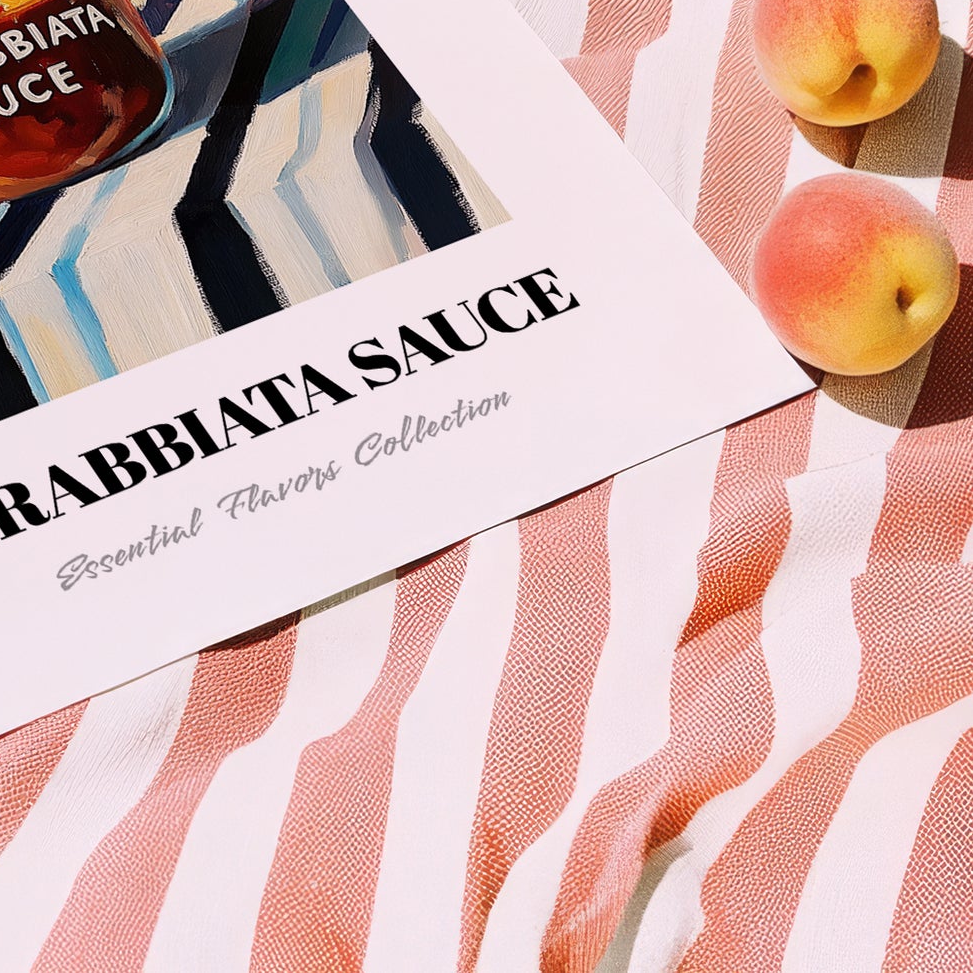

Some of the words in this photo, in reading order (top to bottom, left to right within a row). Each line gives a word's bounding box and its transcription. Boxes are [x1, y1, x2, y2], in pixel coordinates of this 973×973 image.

[348, 267, 580, 391] SAUCE
[56, 507, 204, 591] Essential
[217, 459, 342, 520] Flavors
[354, 391, 512, 467] Collection
